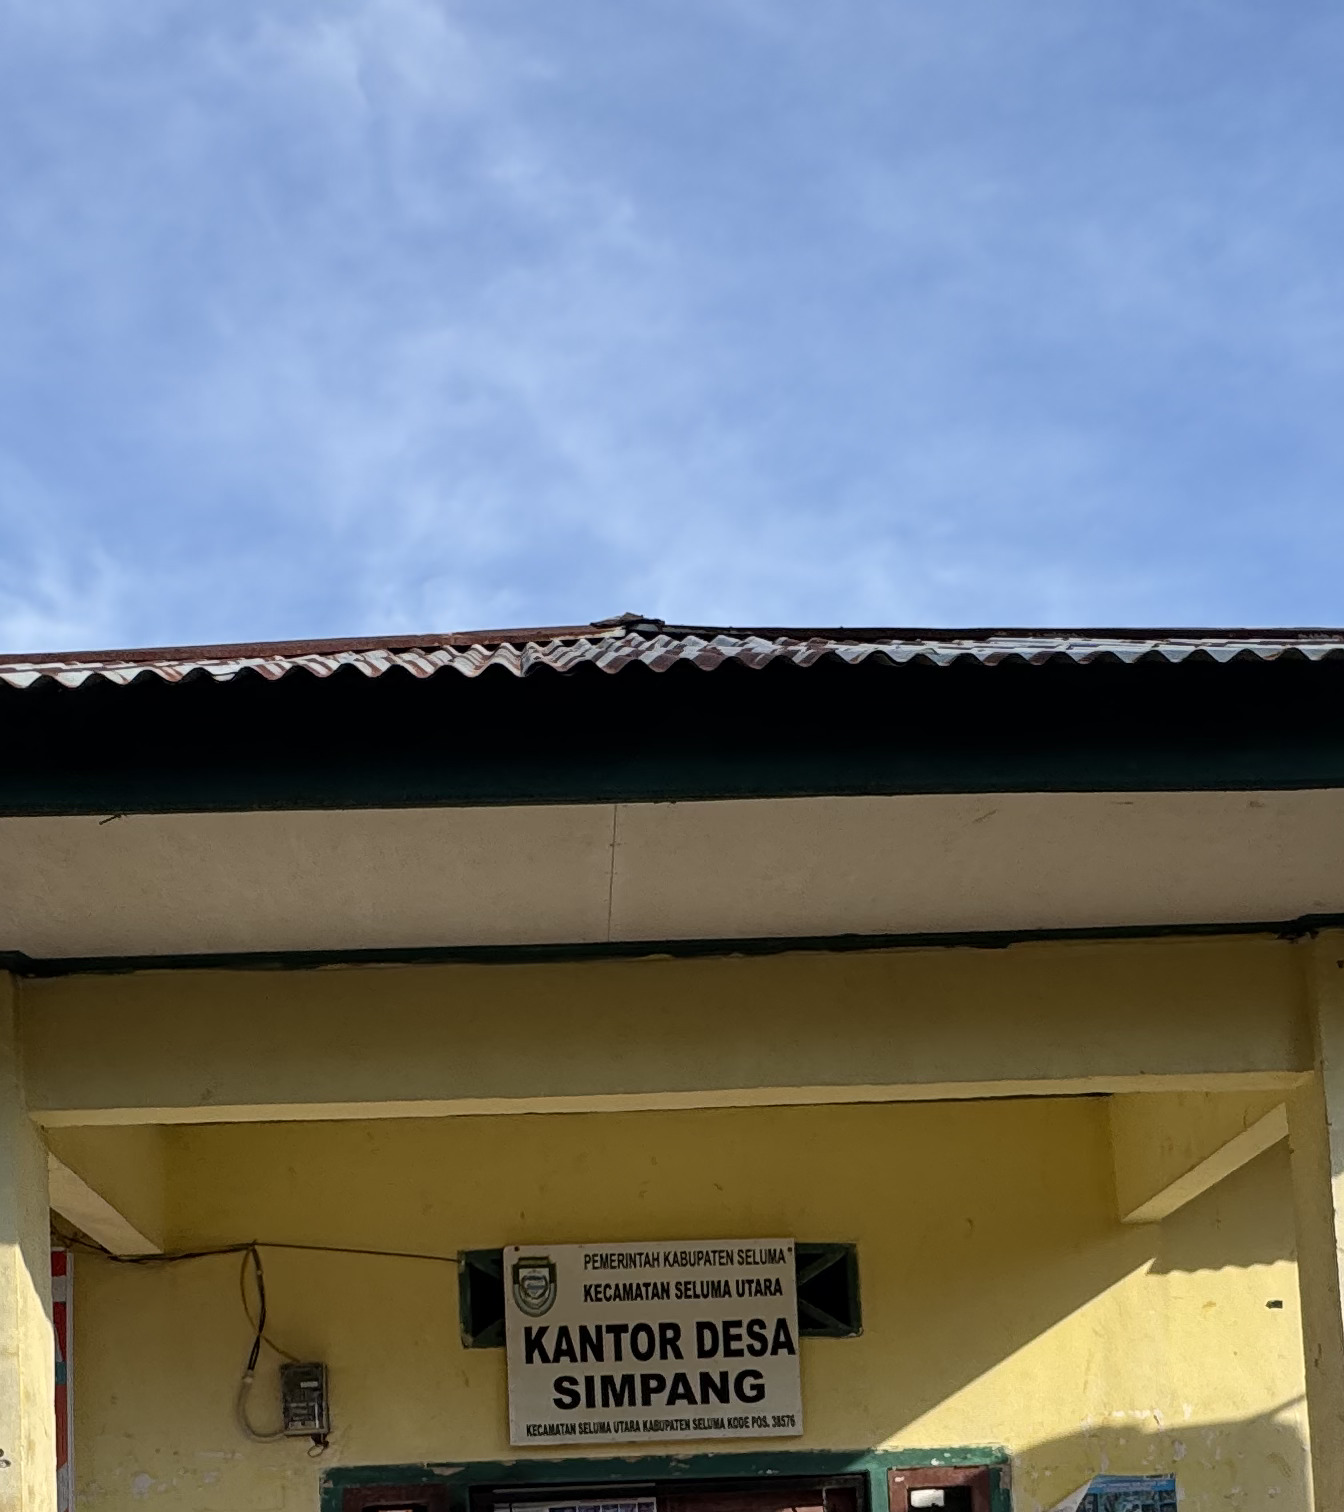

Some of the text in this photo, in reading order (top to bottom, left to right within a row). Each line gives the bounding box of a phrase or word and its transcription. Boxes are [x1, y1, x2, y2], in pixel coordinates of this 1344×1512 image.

[583, 1248, 786, 1270] PEMERINTAH KABUPATEN SELUMA
[583, 1277, 783, 1302] KECAMATAN SELUMA UTARA
[524, 1317, 796, 1364] KANTOR DESA
[552, 1369, 766, 1410] SIMPANG
[526, 1421, 577, 1437] KECAMATAN
[578, 1420, 611, 1436] SELUMA
[613, 1419, 641, 1434] UTARA
[642, 1417, 691, 1433] KABUPATEN
[692, 1417, 726, 1431] SELUMA
[727, 1416, 750, 1429] KODE
